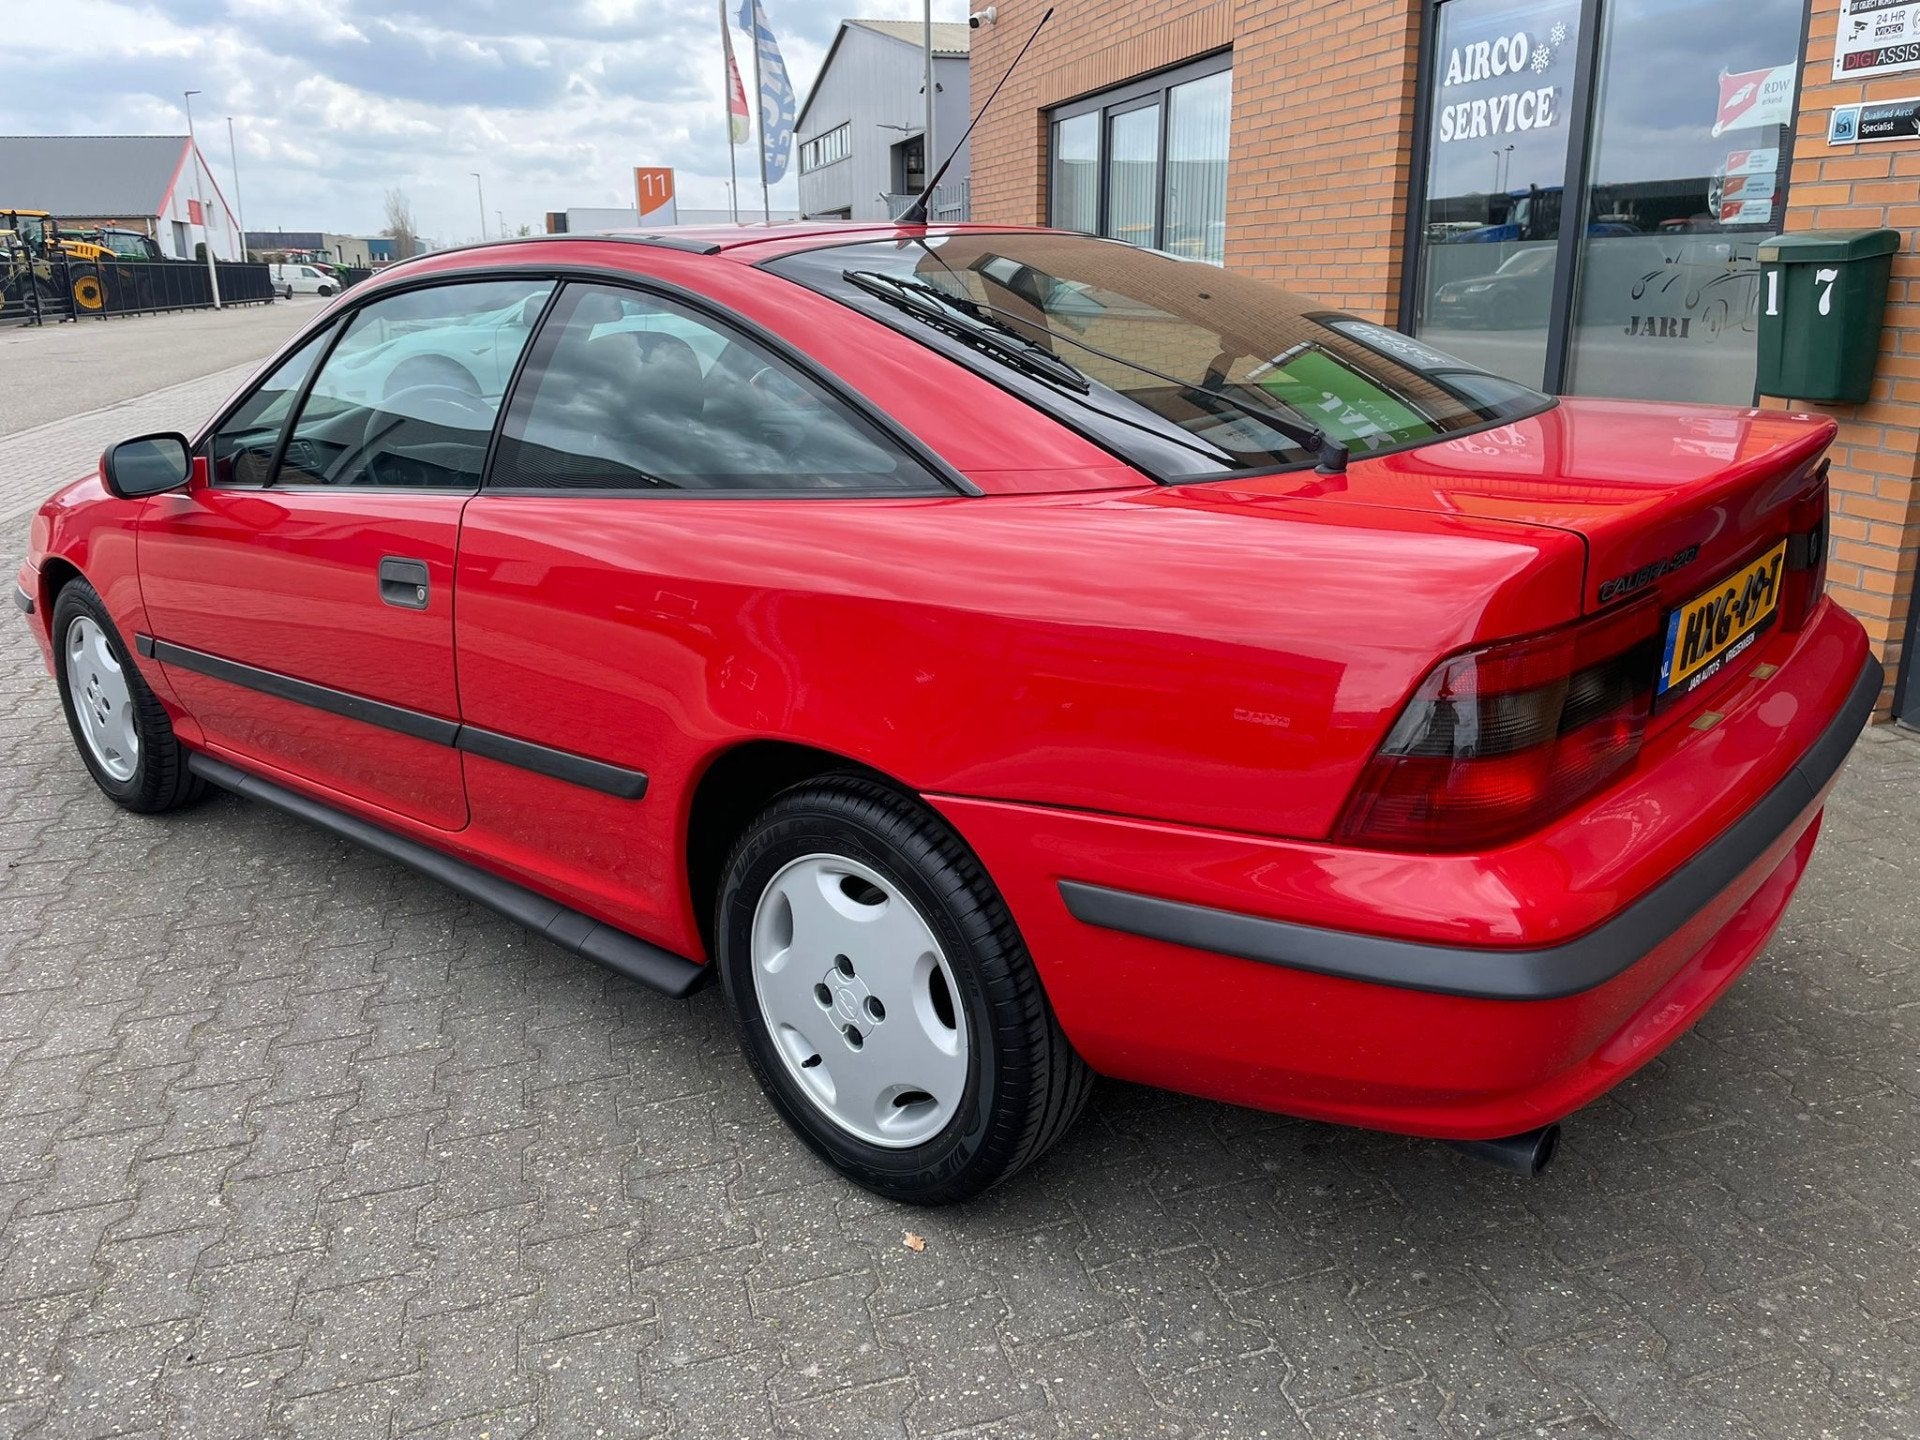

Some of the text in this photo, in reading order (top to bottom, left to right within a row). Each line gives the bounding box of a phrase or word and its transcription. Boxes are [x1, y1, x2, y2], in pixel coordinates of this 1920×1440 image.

[1876, 10, 1906, 25] 24 HR
[1876, 24, 1904, 36] VIDEO
[1444, 32, 1528, 87] AIRCO
[1763, 79, 1791, 94] RDW
[1440, 85, 1554, 142] SERVICE
[1894, 108, 1915, 118] Airco
[1861, 121, 1895, 134] Specialist
[642, 173, 666, 197] 11
[1624, 315, 1692, 339] JARI
